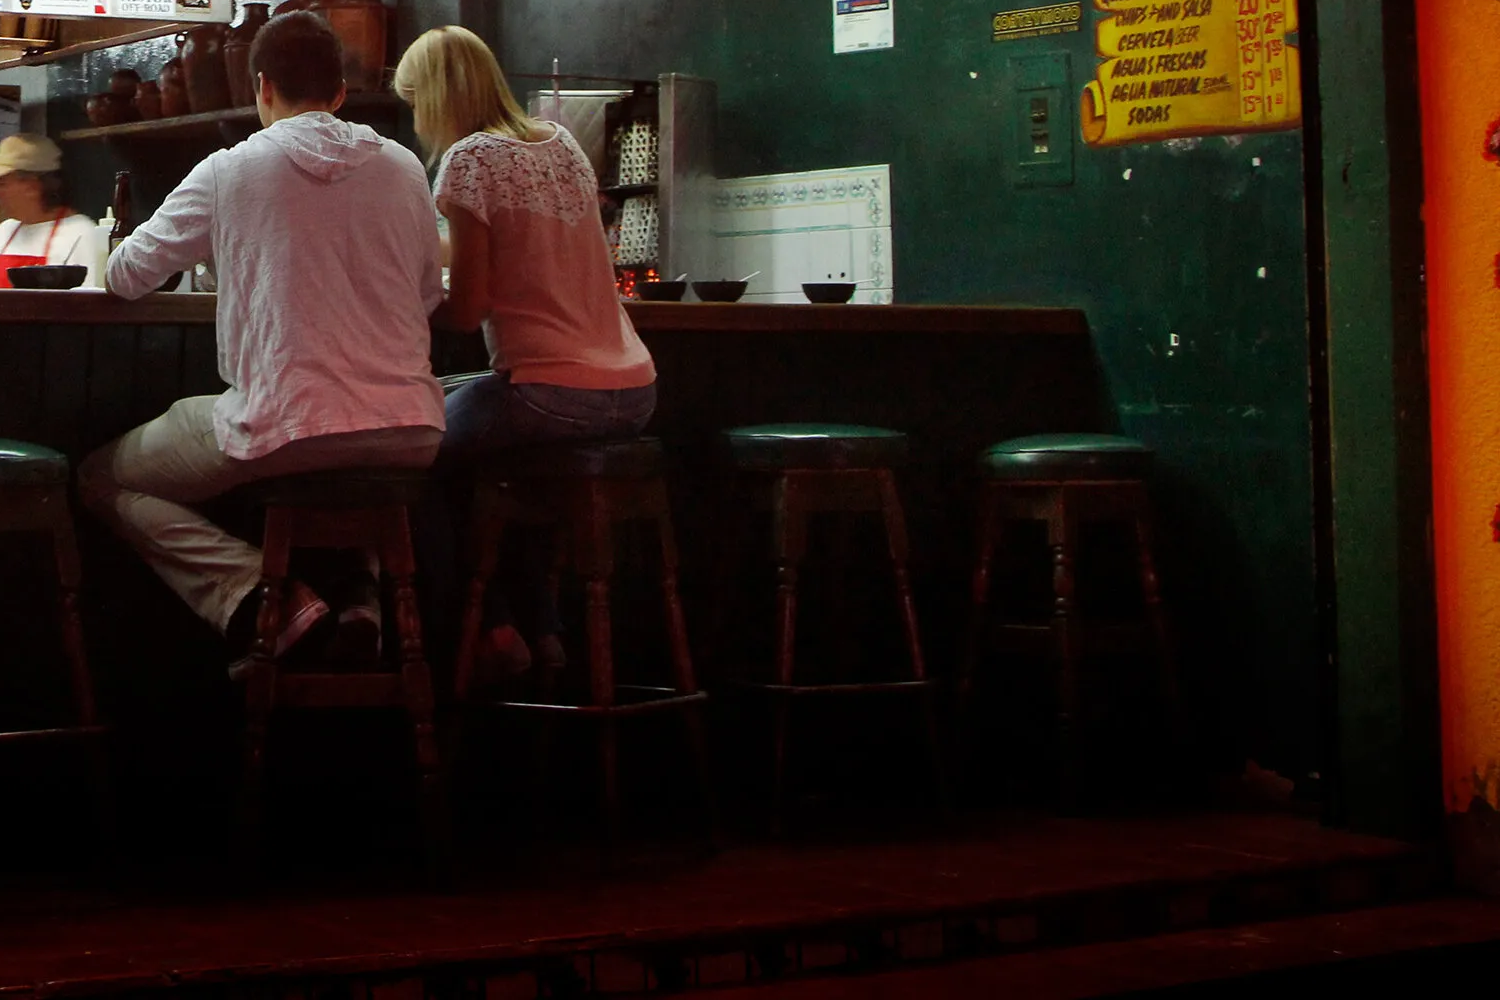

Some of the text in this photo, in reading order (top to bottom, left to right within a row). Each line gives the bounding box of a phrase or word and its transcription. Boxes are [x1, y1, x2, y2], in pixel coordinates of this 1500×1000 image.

[1118, 28, 1174, 52] CERVEZA
[1155, 48, 1208, 74] FRESCAS
[1110, 81, 1147, 104] AGUA
[1148, 76, 1201, 99] NATURAL
[1127, 103, 1173, 127] SODAS
